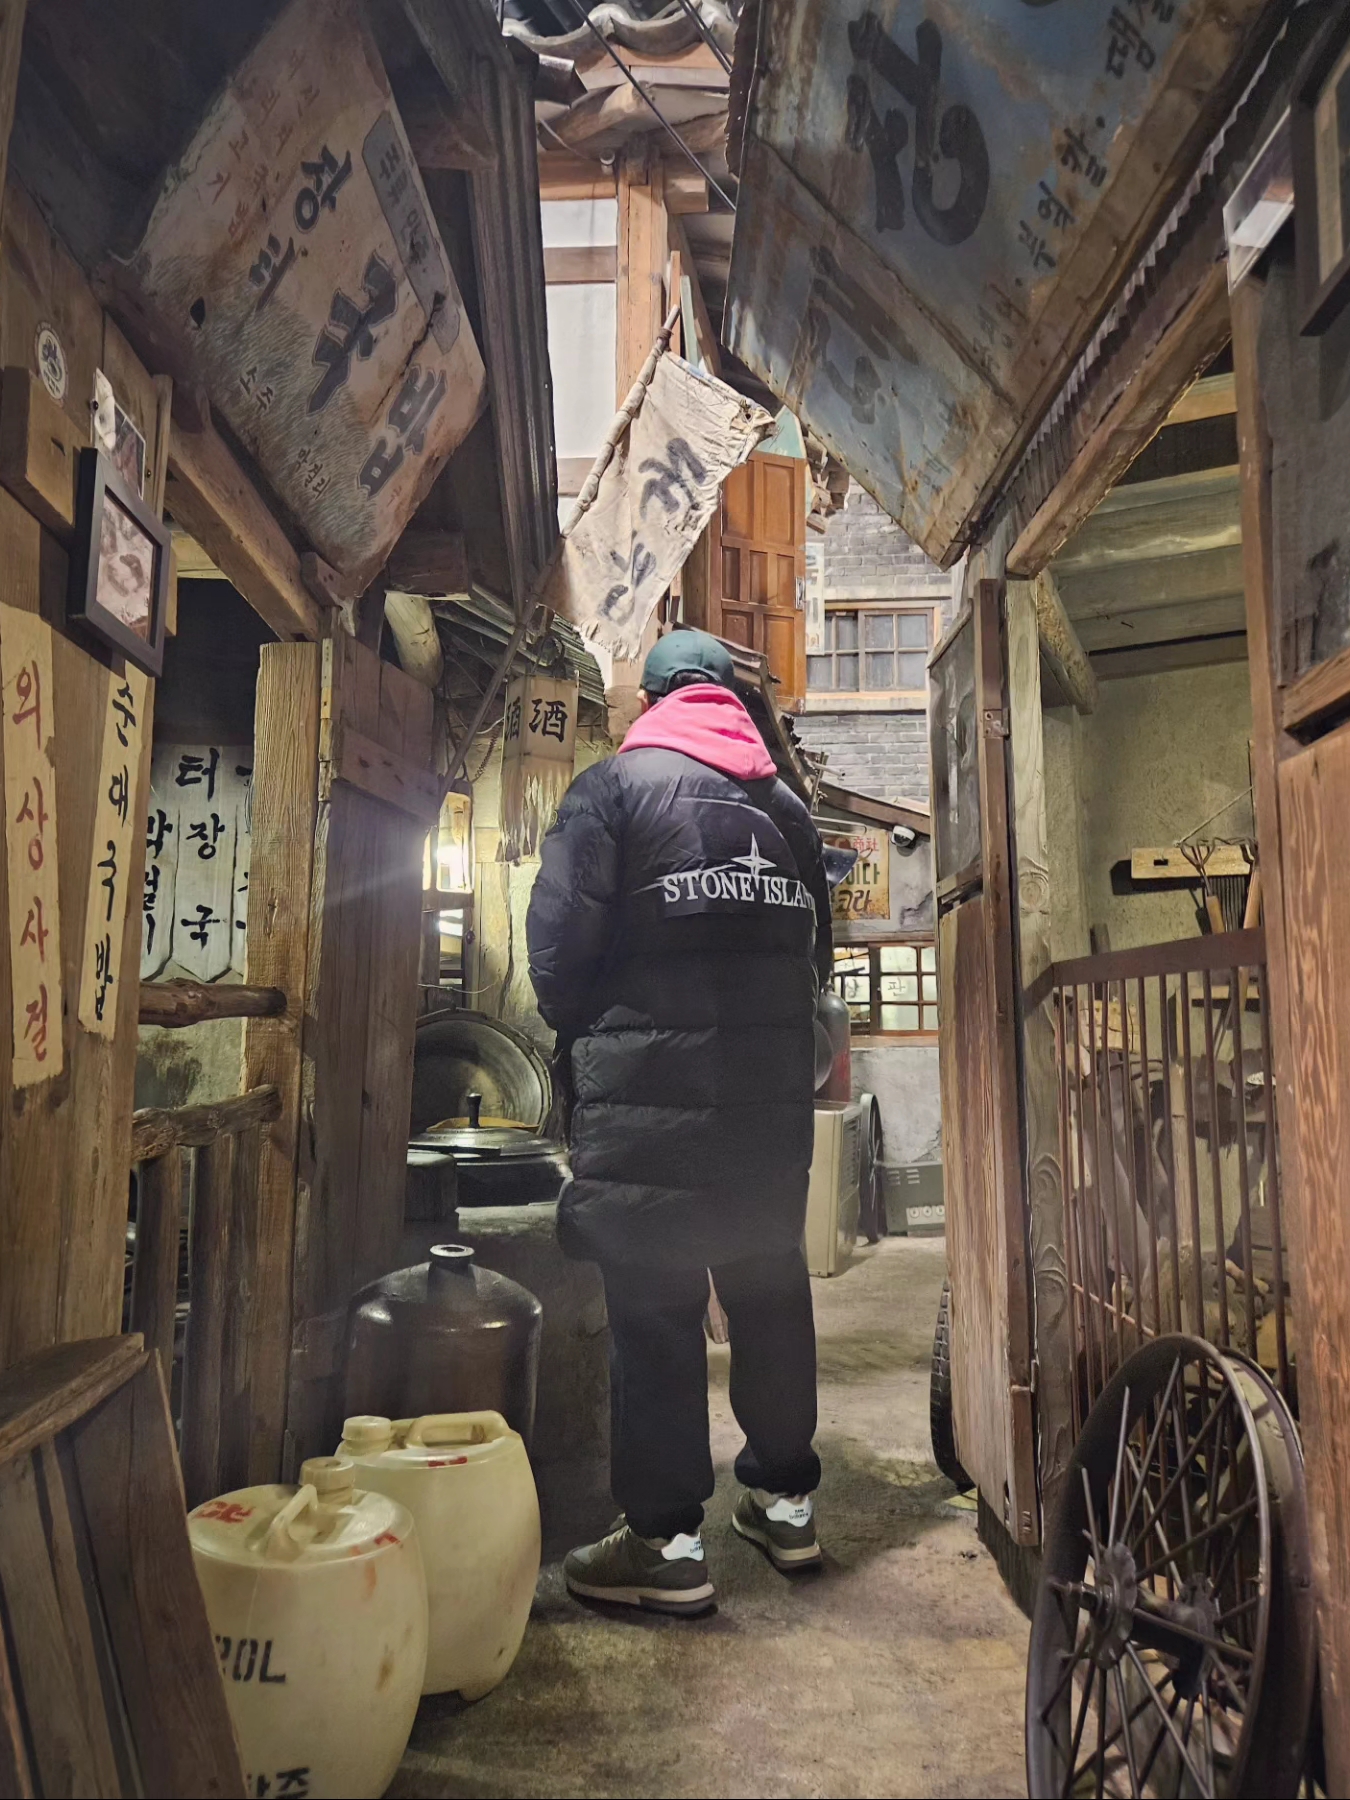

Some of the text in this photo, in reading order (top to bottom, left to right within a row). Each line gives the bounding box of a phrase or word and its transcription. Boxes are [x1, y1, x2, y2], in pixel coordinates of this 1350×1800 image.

[248, 144, 351, 312] 장터
[808, 0, 1048, 425] 대장
[306, 250, 448, 498] 국밥
[294, 447, 331, 500] 막걸리
[528, 698, 568, 743] 酒
[664, 871, 755, 903] STONE
